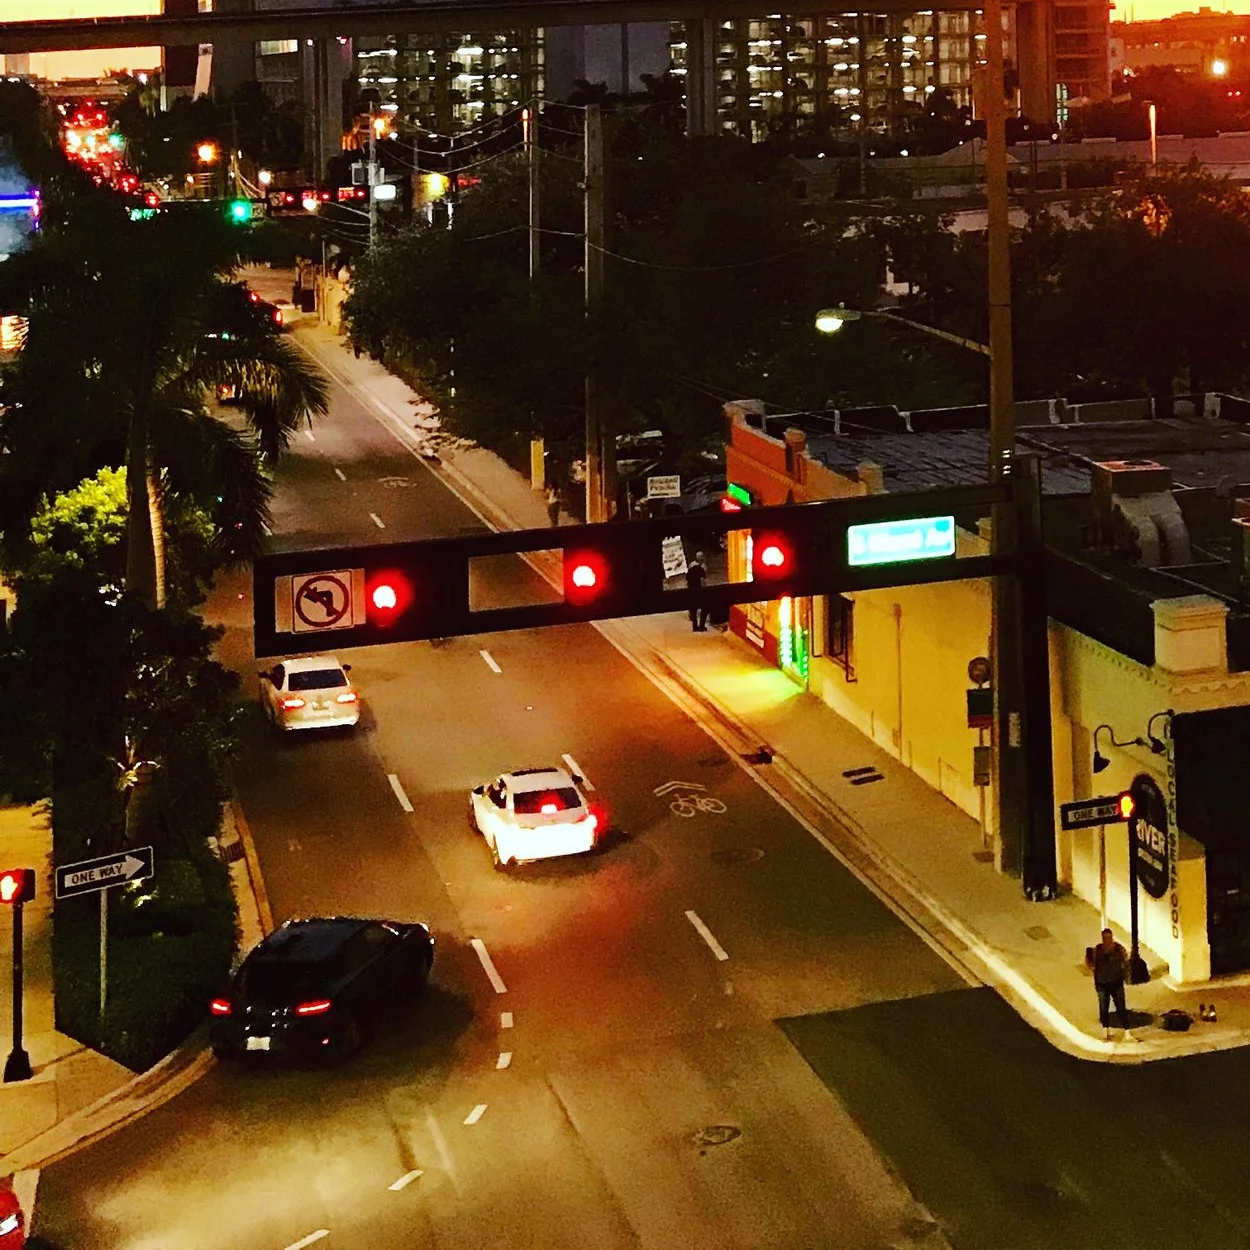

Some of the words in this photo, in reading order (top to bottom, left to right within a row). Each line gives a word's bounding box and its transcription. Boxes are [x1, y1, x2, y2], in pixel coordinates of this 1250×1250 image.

[1074, 808, 1094, 820] ONE
[1097, 804, 1117, 818] WAY
[71, 870, 95, 884] ONE
[100, 865, 123, 878] WAY
[1168, 832, 1179, 939] SEAFOOD
